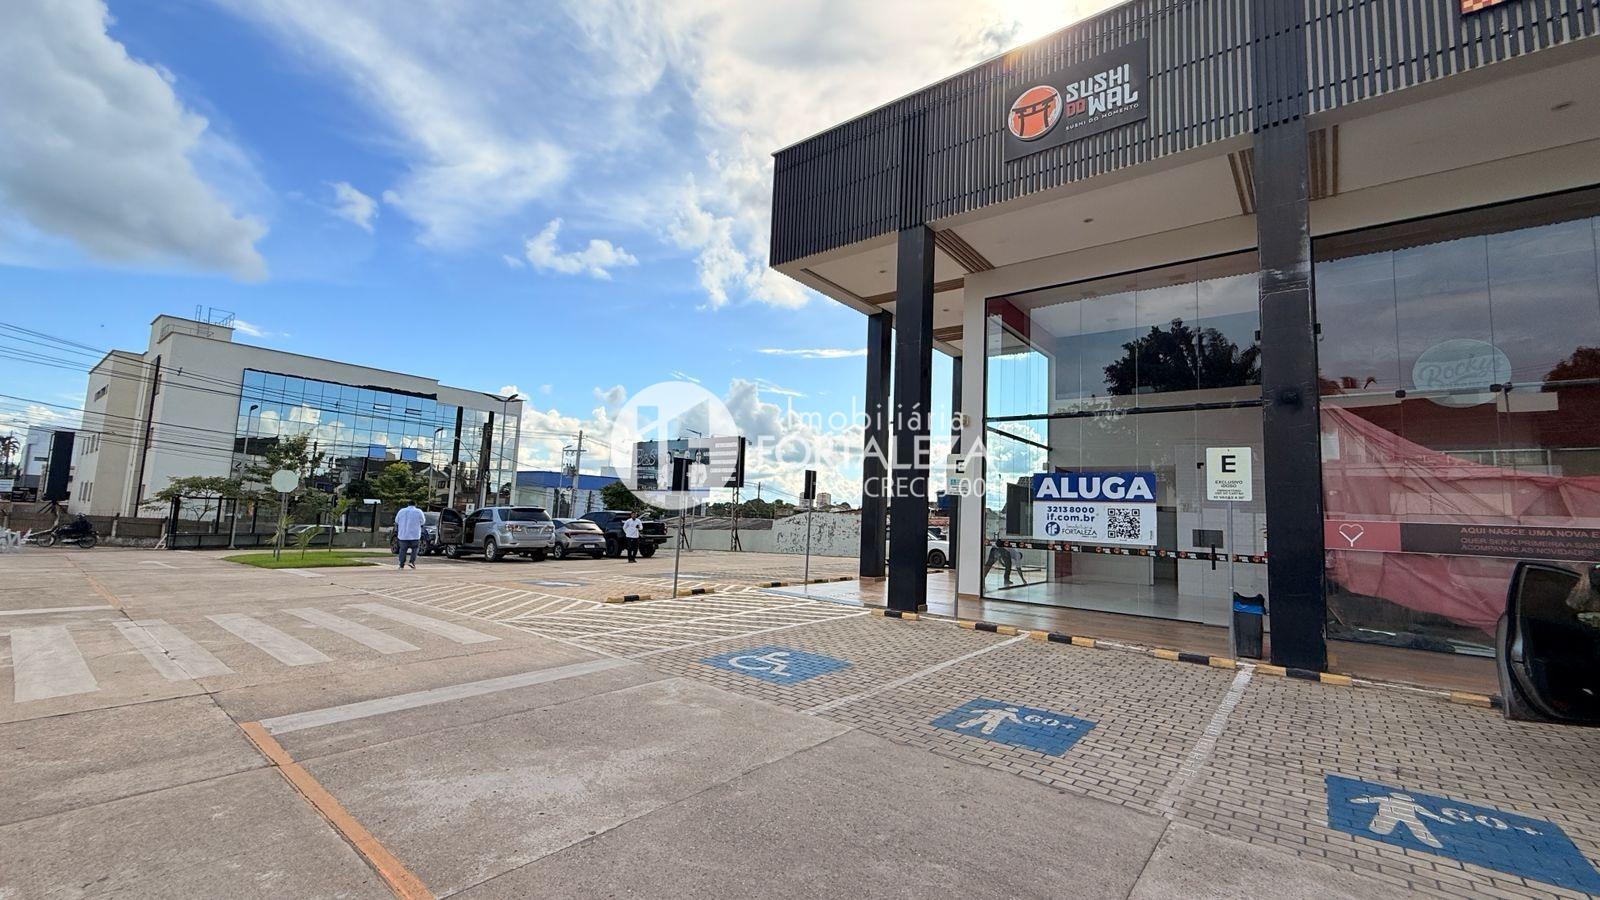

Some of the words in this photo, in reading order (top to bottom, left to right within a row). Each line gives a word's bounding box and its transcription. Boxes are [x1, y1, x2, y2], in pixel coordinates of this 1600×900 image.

[1066, 64, 1130, 103] SUSHI
[1065, 98, 1086, 118] DO
[1088, 83, 1139, 117] WAL
[1065, 120, 1087, 131] SUSHI
[1088, 116, 1099, 124] DO
[1101, 103, 1140, 118] MOMENTO
[1221, 455, 1236, 473] E
[1036, 476, 1154, 500] ALUGA
[1046, 513, 1095, 522] if.com.br
[1062, 528, 1098, 537] FORTALEZA
[1461, 527, 1486, 535] AQUI
[1489, 528, 1527, 537] NASCE
[1529, 529, 1553, 537] UMA
[1556, 530, 1589, 538] NOVA
[1024, 714, 1077, 729] 60+
[1441, 807, 1544, 836] 60+
